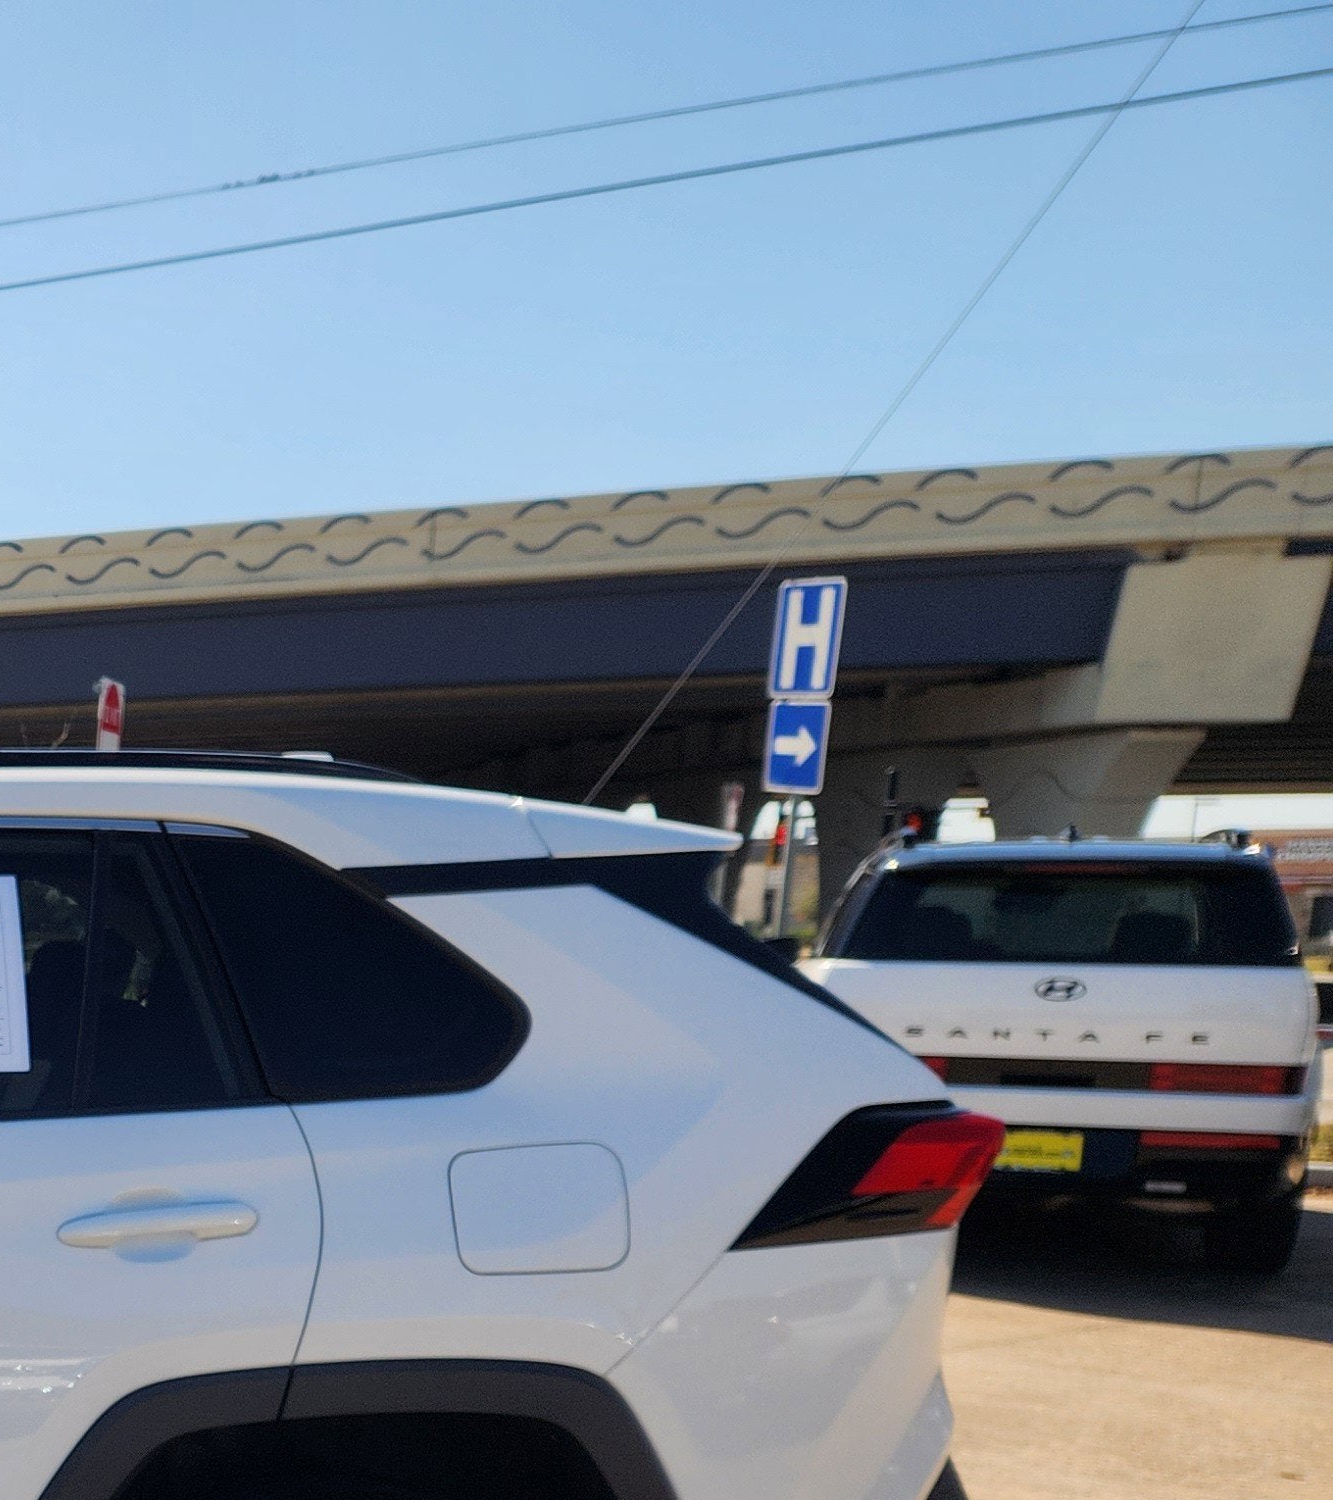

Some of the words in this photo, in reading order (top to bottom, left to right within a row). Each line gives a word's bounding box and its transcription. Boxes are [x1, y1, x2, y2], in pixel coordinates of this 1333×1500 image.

[779, 587, 836, 690] H
[905, 1024, 1100, 1043] SANTA
[1145, 1030, 1210, 1045] FE
